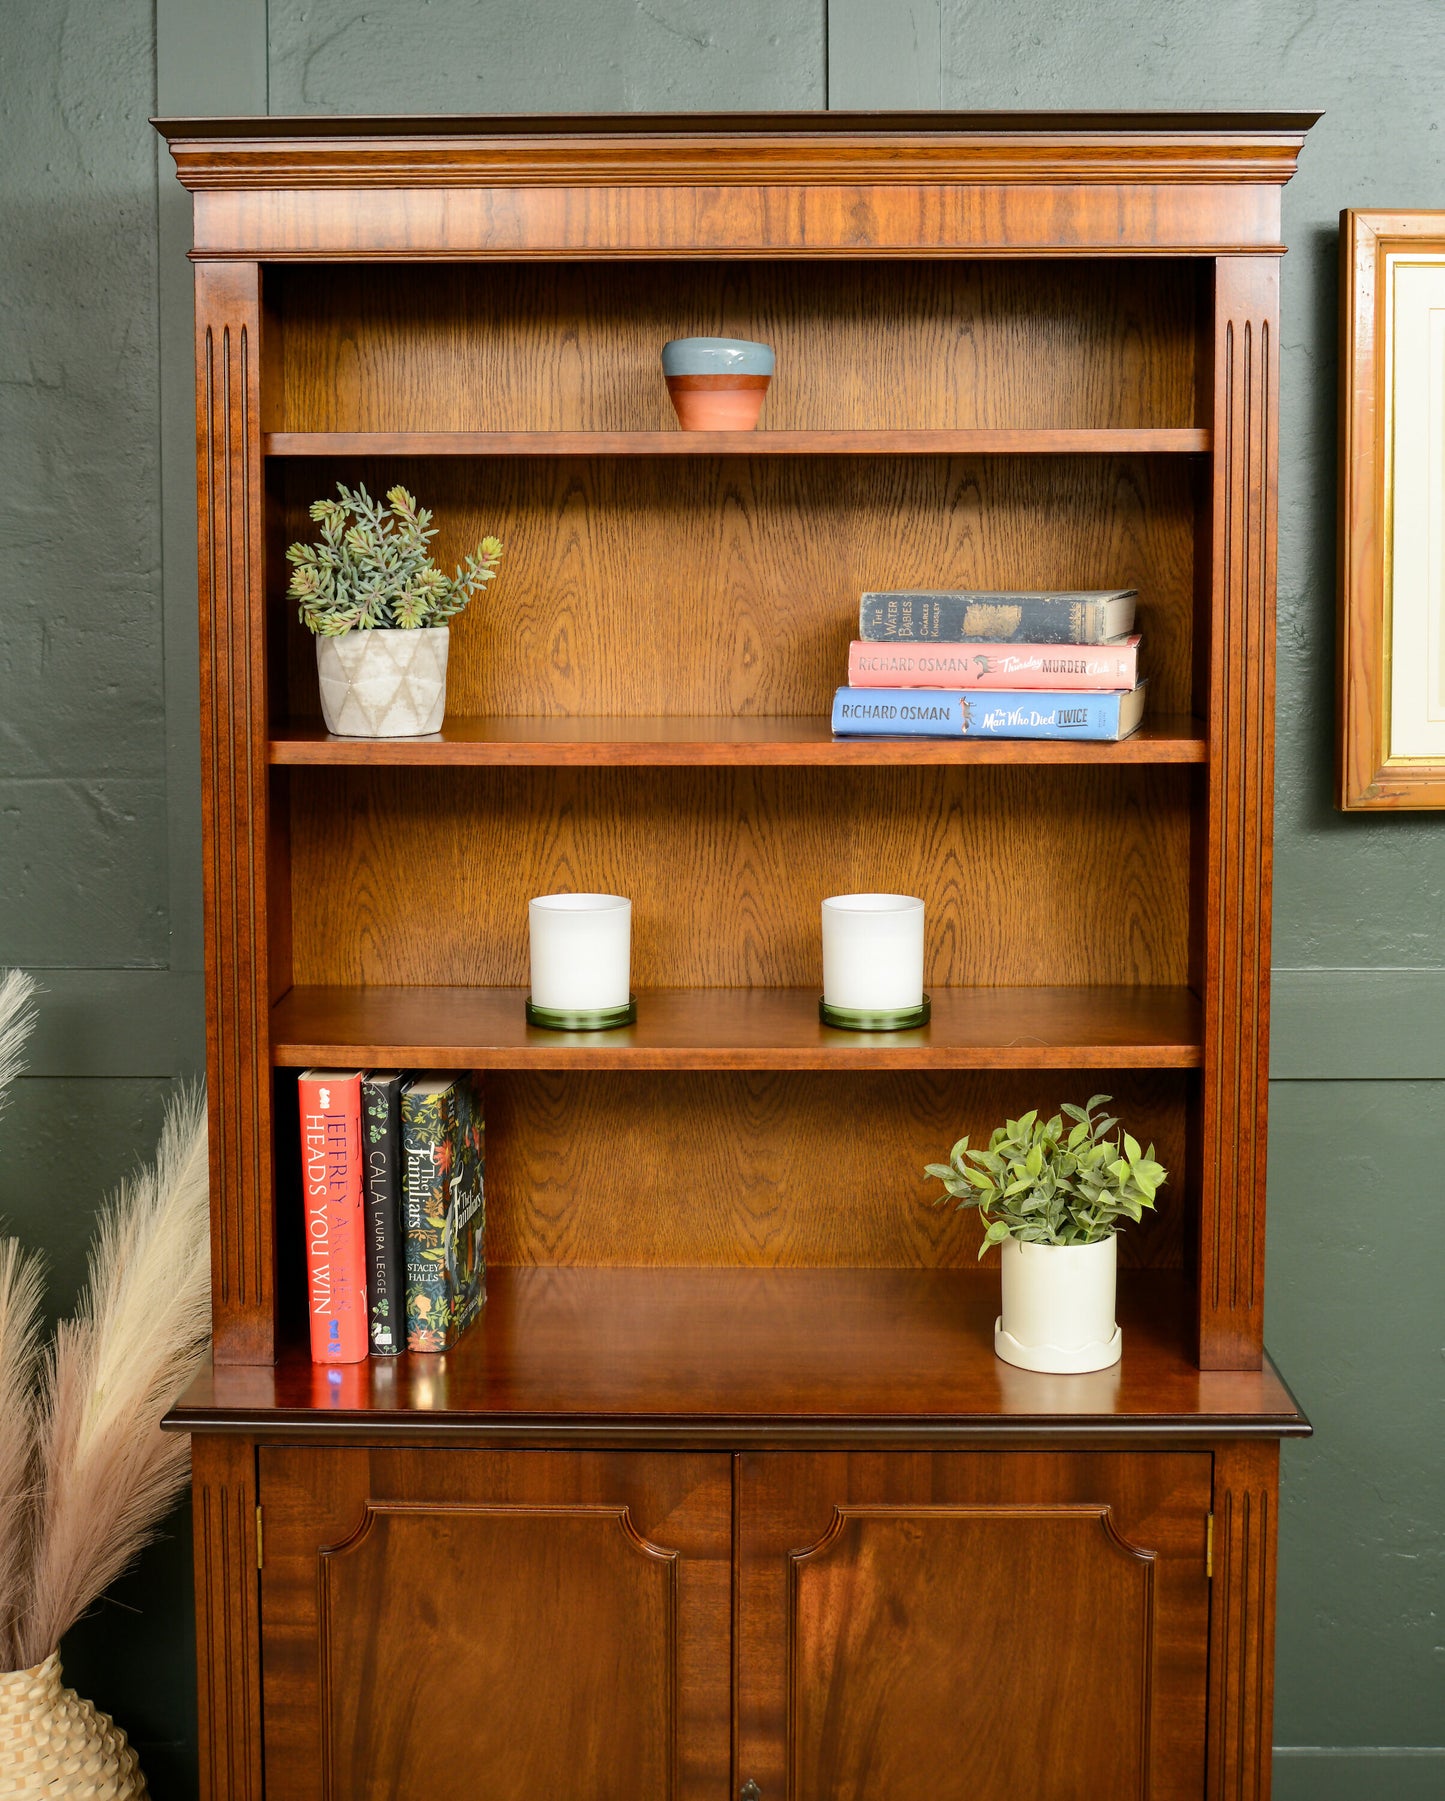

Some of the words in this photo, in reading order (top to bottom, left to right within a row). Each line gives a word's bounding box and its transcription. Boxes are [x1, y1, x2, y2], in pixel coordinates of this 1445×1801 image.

[873, 609, 883, 626] THE
[884, 601, 898, 636] WATER
[898, 601, 914, 637] BABIES
[920, 603, 929, 636] CHARLES
[931, 602, 940, 637] KINGSLEY
[918, 658, 968, 672] OSMAN
[1042, 659, 1087, 673] MURDER
[900, 706, 950, 720] OSMAN
[982, 712, 1005, 732] Man
[1006, 707, 1029, 726] Who
[1030, 710, 1056, 727] Died
[1057, 708, 1088, 725] TWICE
[994, 708, 1006, 717] The
[306, 1114, 327, 1195] HEADS
[324, 1113, 349, 1204] JEFFREY
[369, 1151, 388, 1205] CALA
[404, 1139, 436, 1228] Familiars
[420, 1165, 435, 1192] The
[309, 1204, 329, 1256] YOU
[374, 1212, 386, 1251] LAURA
[376, 1255, 388, 1294] LEGGE
[407, 1263, 440, 1273] STACEY
[408, 1272, 440, 1282] HALLS
[312, 1264, 332, 1315] WIN
